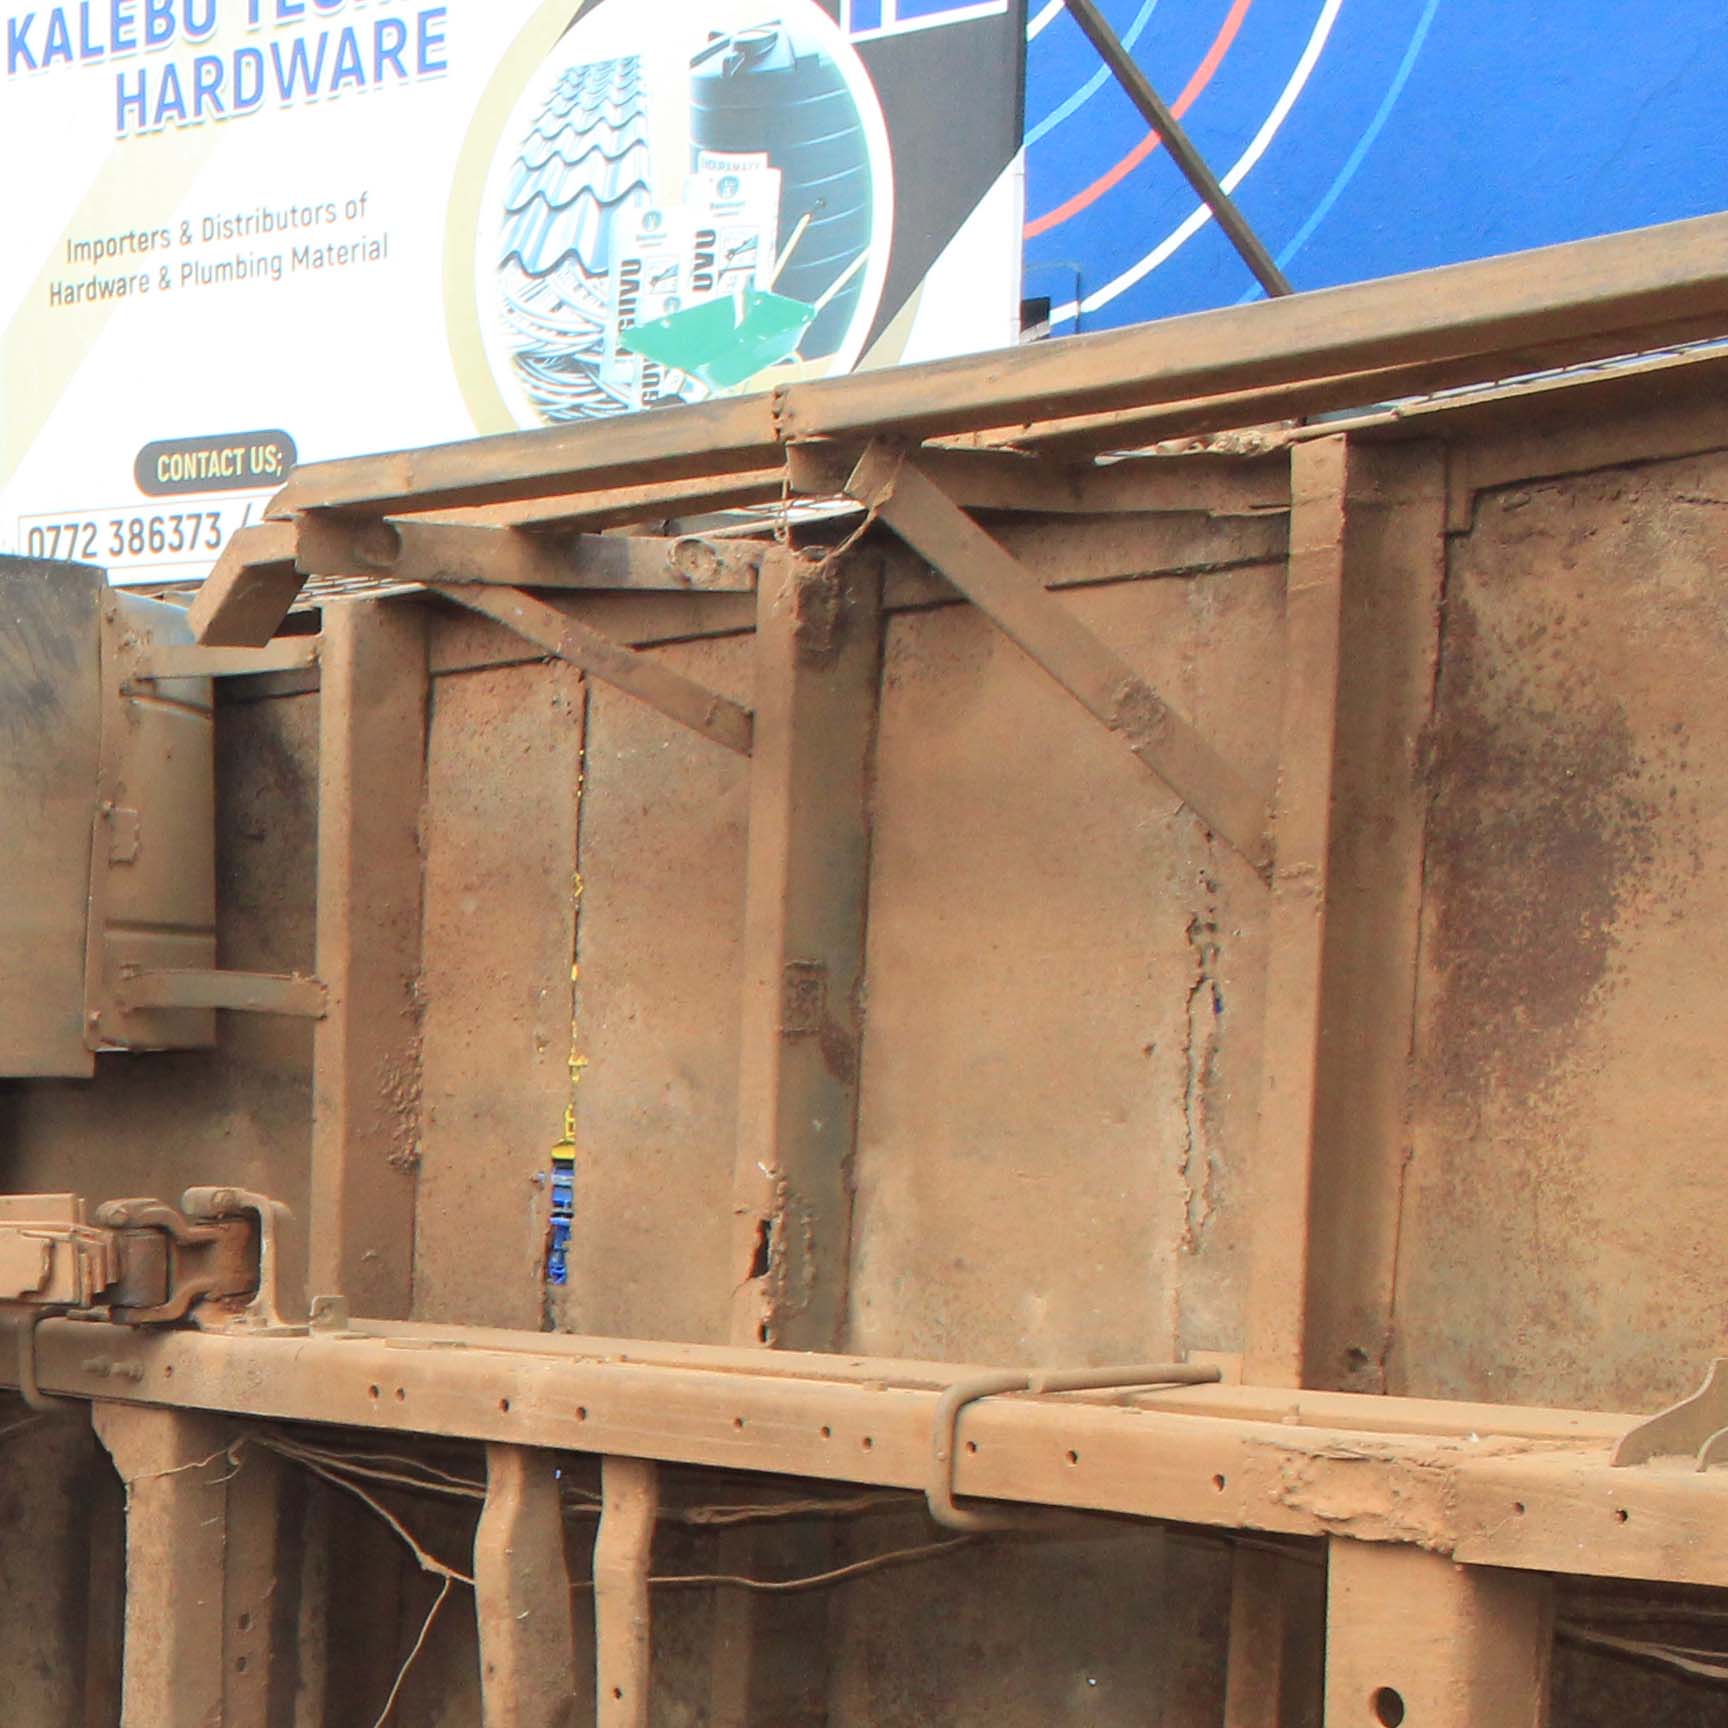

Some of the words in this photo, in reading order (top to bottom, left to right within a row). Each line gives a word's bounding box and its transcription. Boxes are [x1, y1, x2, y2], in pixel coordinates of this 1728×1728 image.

[117, 6, 448, 132] HARDWARE
[66, 227, 171, 265] Importers
[179, 220, 194, 246] &
[202, 202, 338, 243] Distributors
[345, 190, 369, 221] of
[49, 274, 150, 308] Hardware
[158, 265, 172, 291] &
[180, 251, 282, 289] Plumbing
[291, 232, 389, 272] Material
[157, 446, 245, 482] CONTACT
[28, 521, 98, 562] 0772
[108, 511, 222, 558] 386373
